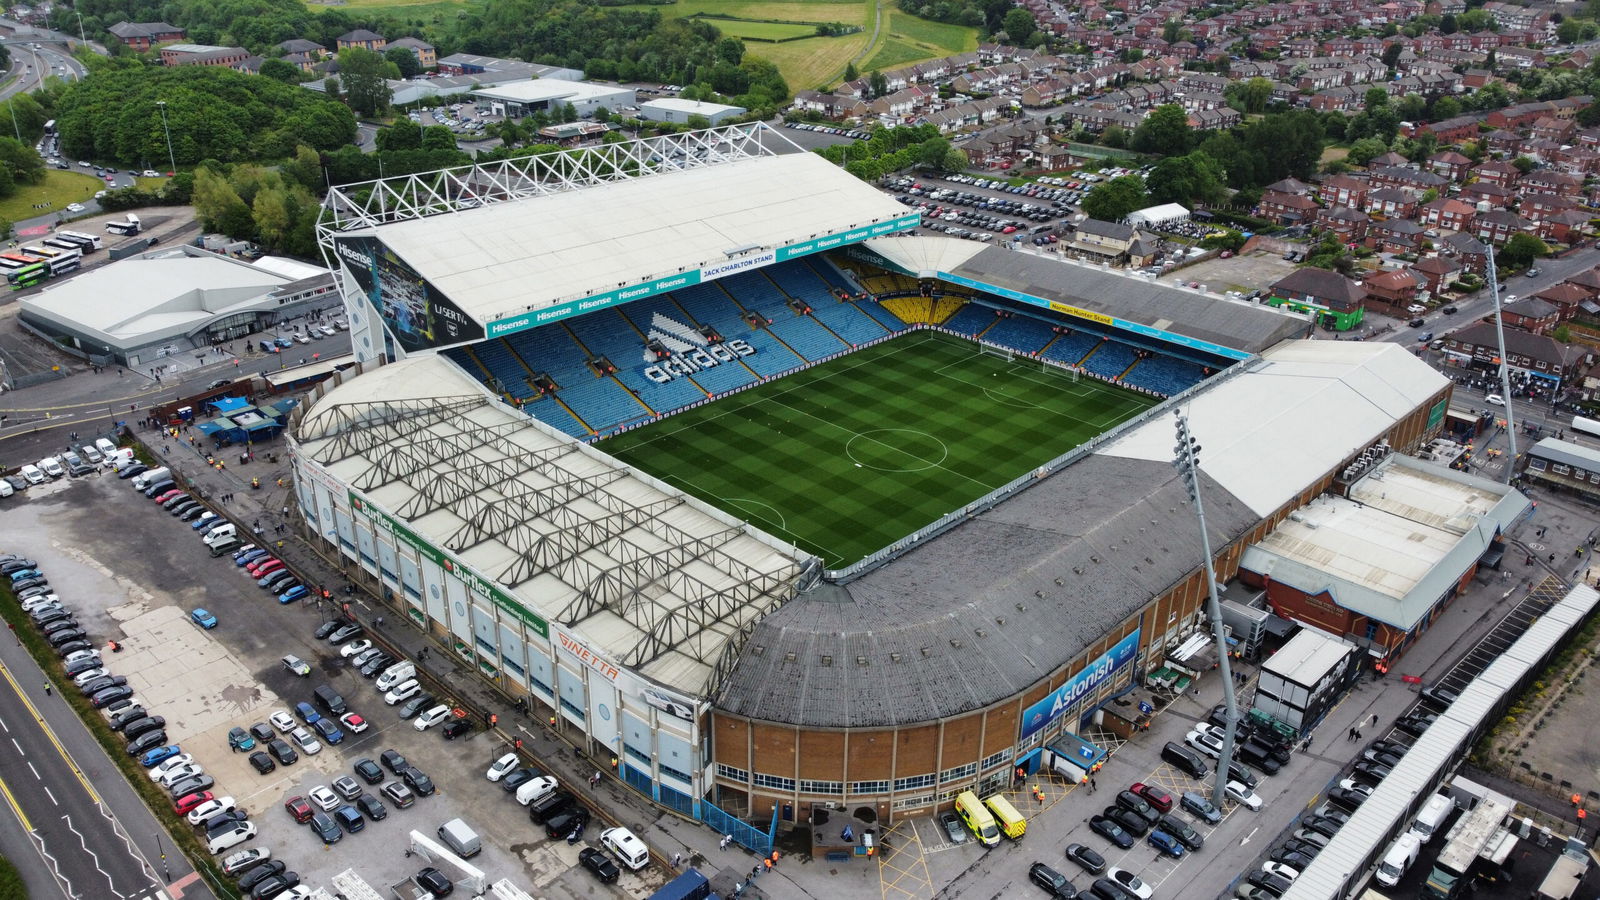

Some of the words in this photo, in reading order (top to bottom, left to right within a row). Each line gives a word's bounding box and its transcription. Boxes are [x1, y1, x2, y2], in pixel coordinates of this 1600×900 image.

[872, 223, 894, 234] Hisense
[897, 217, 919, 228] Hisense
[817, 237, 841, 248] Hisense
[845, 230, 868, 241] Hisense
[338, 242, 373, 267] Hisense
[788, 244, 813, 256] Hisense
[847, 247, 884, 265] Hisense
[704, 267, 720, 278] JACK
[720, 260, 753, 273] CHARLTON
[753, 254, 773, 264] STAND
[656, 277, 686, 290] Hisense
[618, 285, 650, 300] Hisense
[579, 295, 612, 311] Hisense
[536, 306, 572, 322] Hisense
[1051, 303, 1073, 313] Norman
[1073, 308, 1093, 318] Hunter
[1093, 314, 1111, 324] Stand
[492, 318, 529, 334] Hisense
[643, 339, 758, 384] adidas
[361, 500, 394, 533] Burflex
[452, 562, 493, 600] Burflex
[523, 615, 544, 634] Limited
[558, 632, 619, 680] GINETTA
[1050, 654, 1114, 717] Astonish
